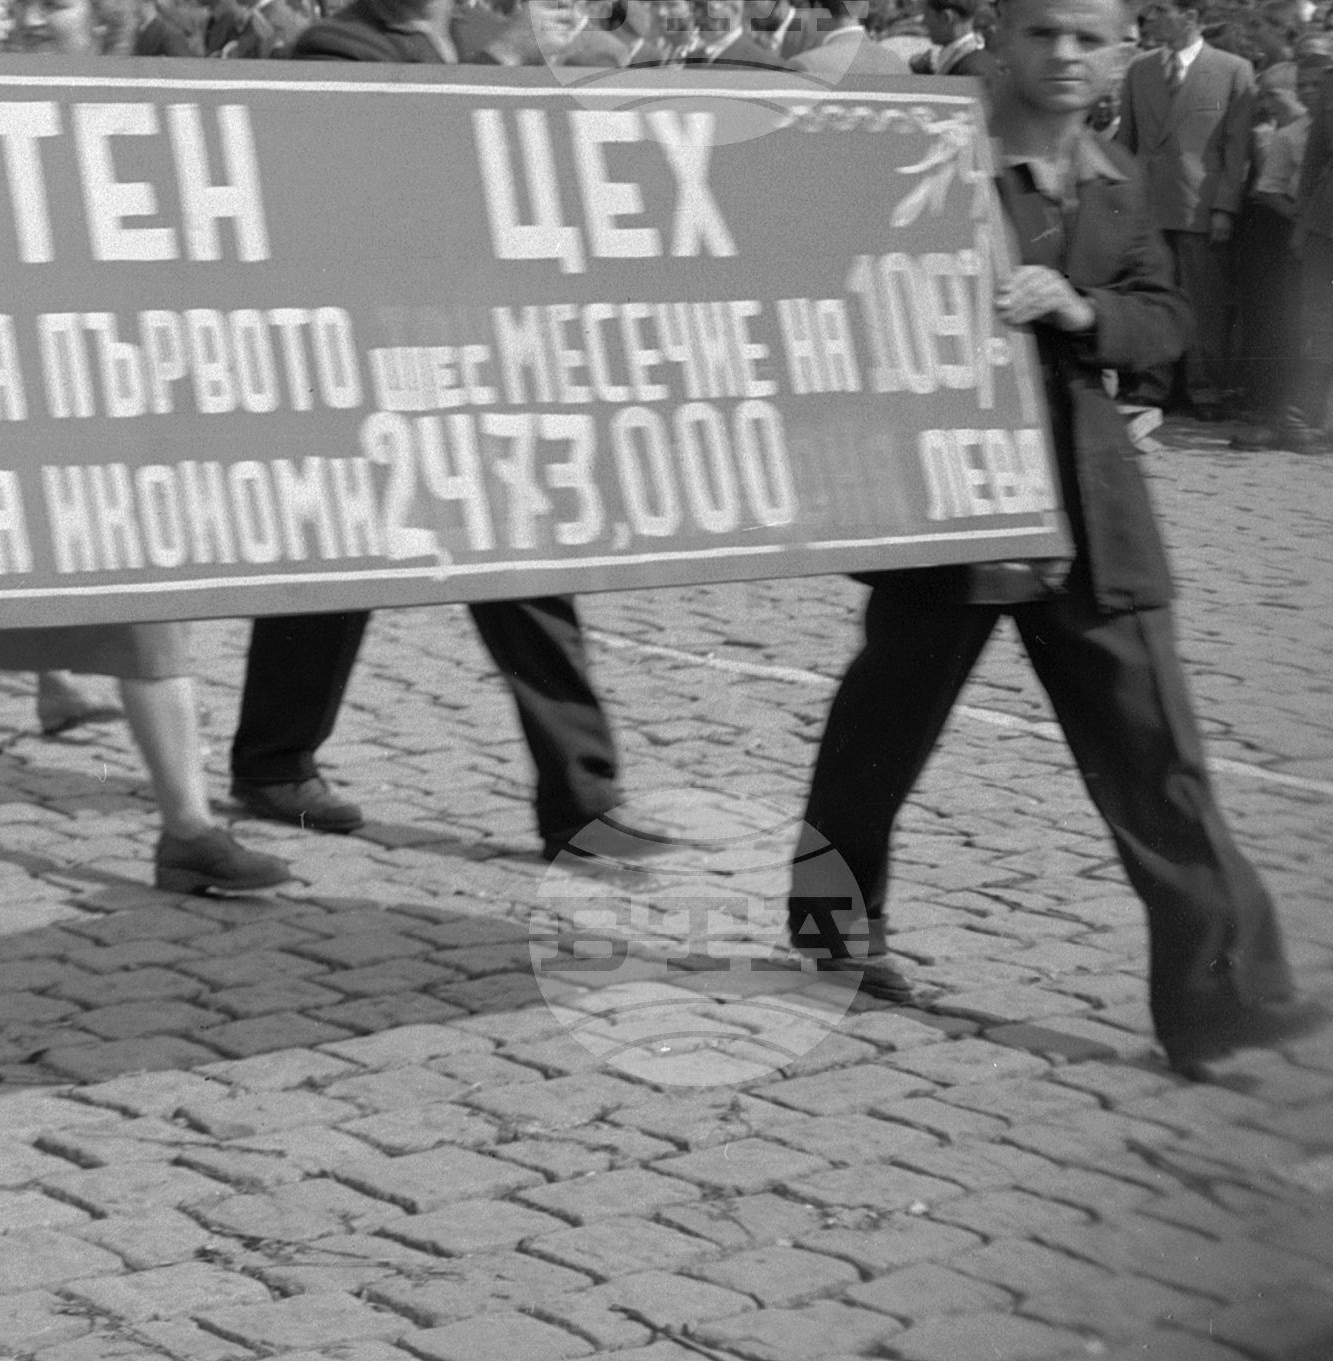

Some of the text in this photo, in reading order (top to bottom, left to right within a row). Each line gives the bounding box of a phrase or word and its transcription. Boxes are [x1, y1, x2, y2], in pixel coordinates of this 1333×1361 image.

[471, 107, 738, 274] ЦЕХ
[36, 305, 364, 419] ПЪРВОТО
[490, 300, 778, 405] МЕСЕЧИЕ
[776, 297, 862, 395] НА
